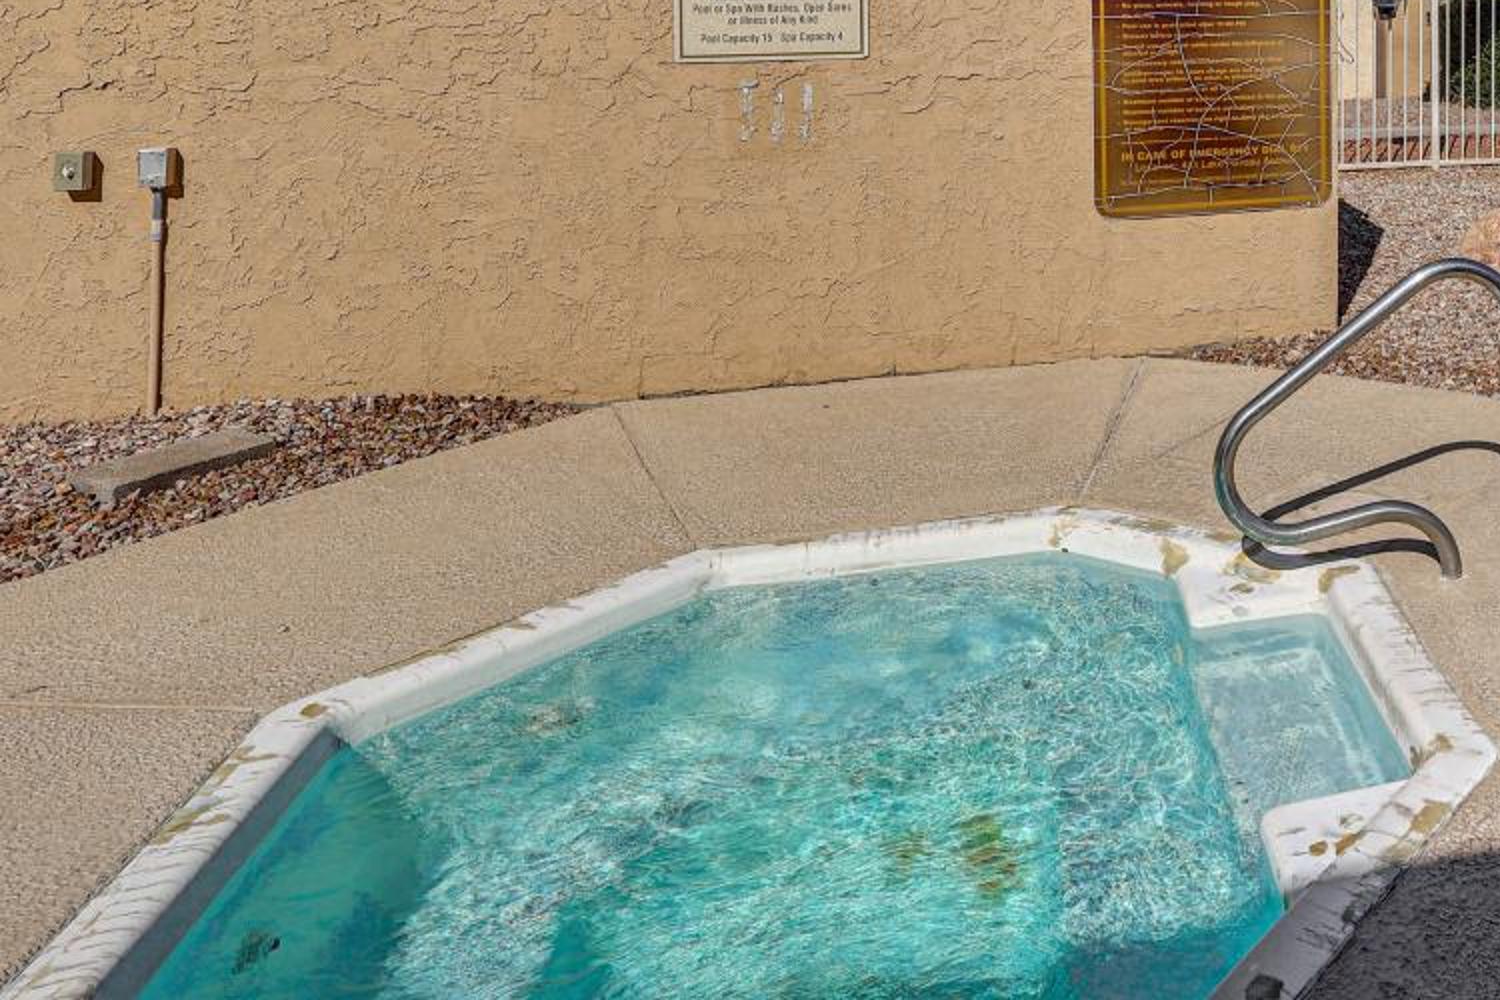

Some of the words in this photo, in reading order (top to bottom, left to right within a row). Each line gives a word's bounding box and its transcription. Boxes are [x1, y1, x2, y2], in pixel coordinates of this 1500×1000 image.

[692, 4, 712, 13] Pool
[714, 5, 723, 13] or
[726, 4, 743, 14] Spa
[803, 2, 825, 13] Open
[827, 2, 852, 12] Sores
[769, 15, 779, 24] of
[781, 15, 797, 25] Any
[700, 34, 720, 43] Pool
[722, 33, 760, 44] Capacity
[780, 32, 797, 43] Spa
[800, 31, 835, 43] Capacity
[837, 31, 843, 41] 4
[1121, 153, 1134, 162] IN
[1172, 150, 1186, 160] OF
